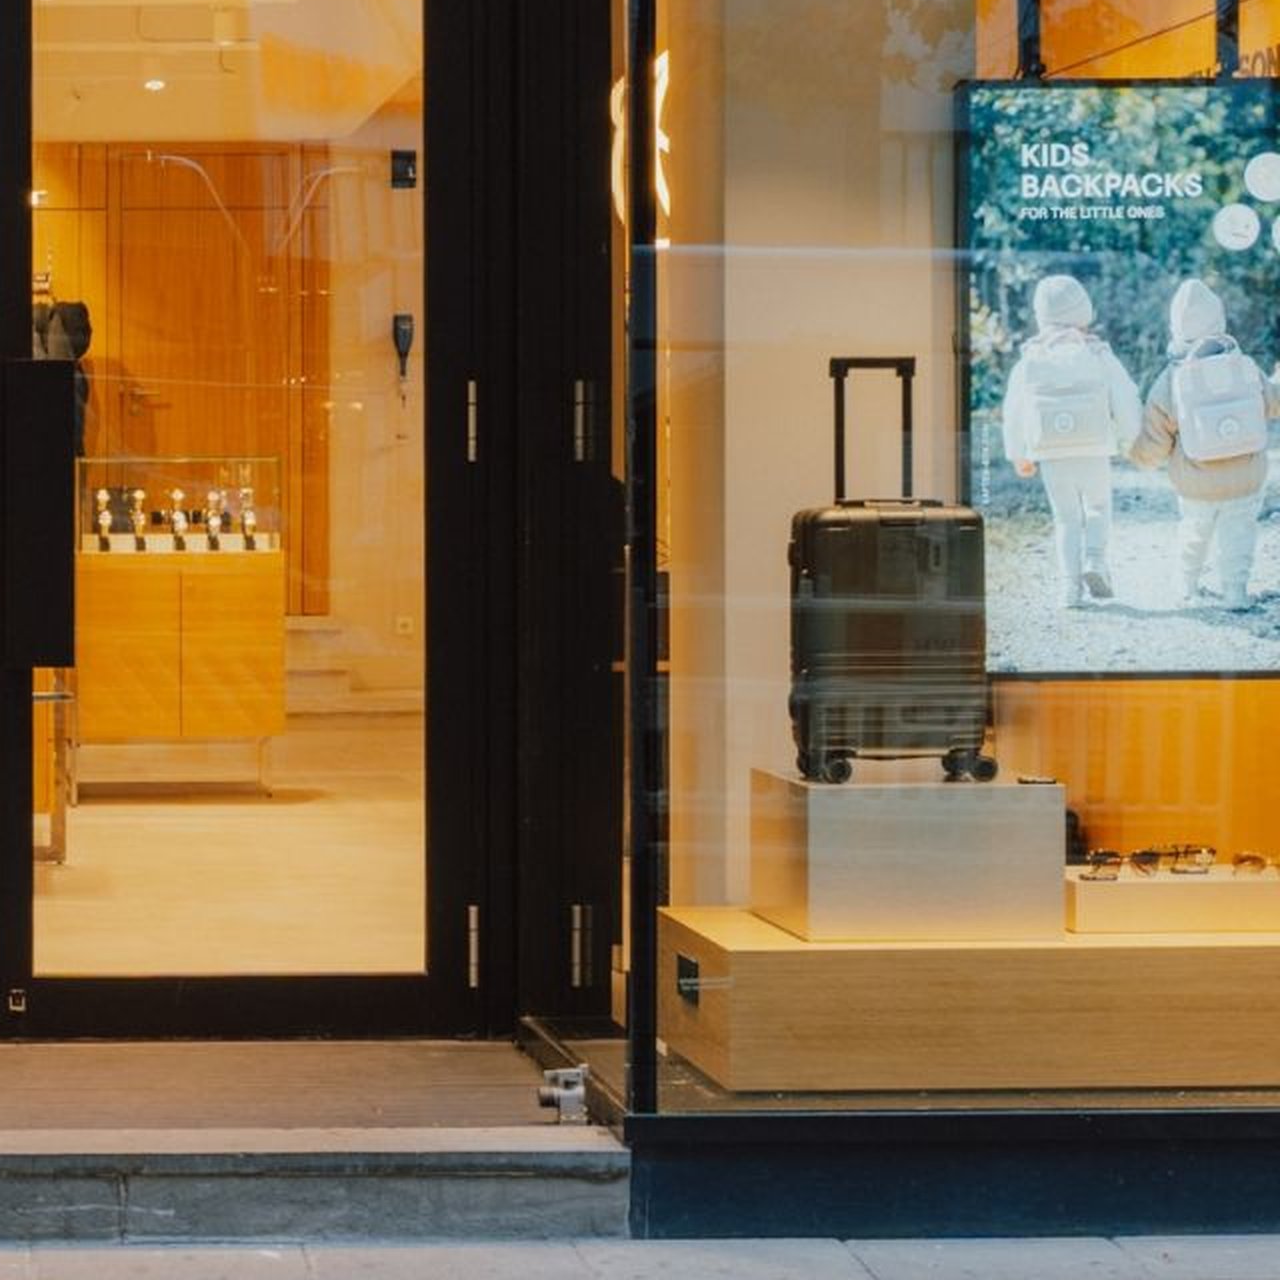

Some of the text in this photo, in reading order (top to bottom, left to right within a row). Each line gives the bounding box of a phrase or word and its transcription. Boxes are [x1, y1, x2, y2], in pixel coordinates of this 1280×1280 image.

[1021, 143, 1090, 167] KIDS
[1021, 173, 1203, 198] BACKPACKS
[1020, 206, 1166, 220] FOR THE LITTLE ONES
